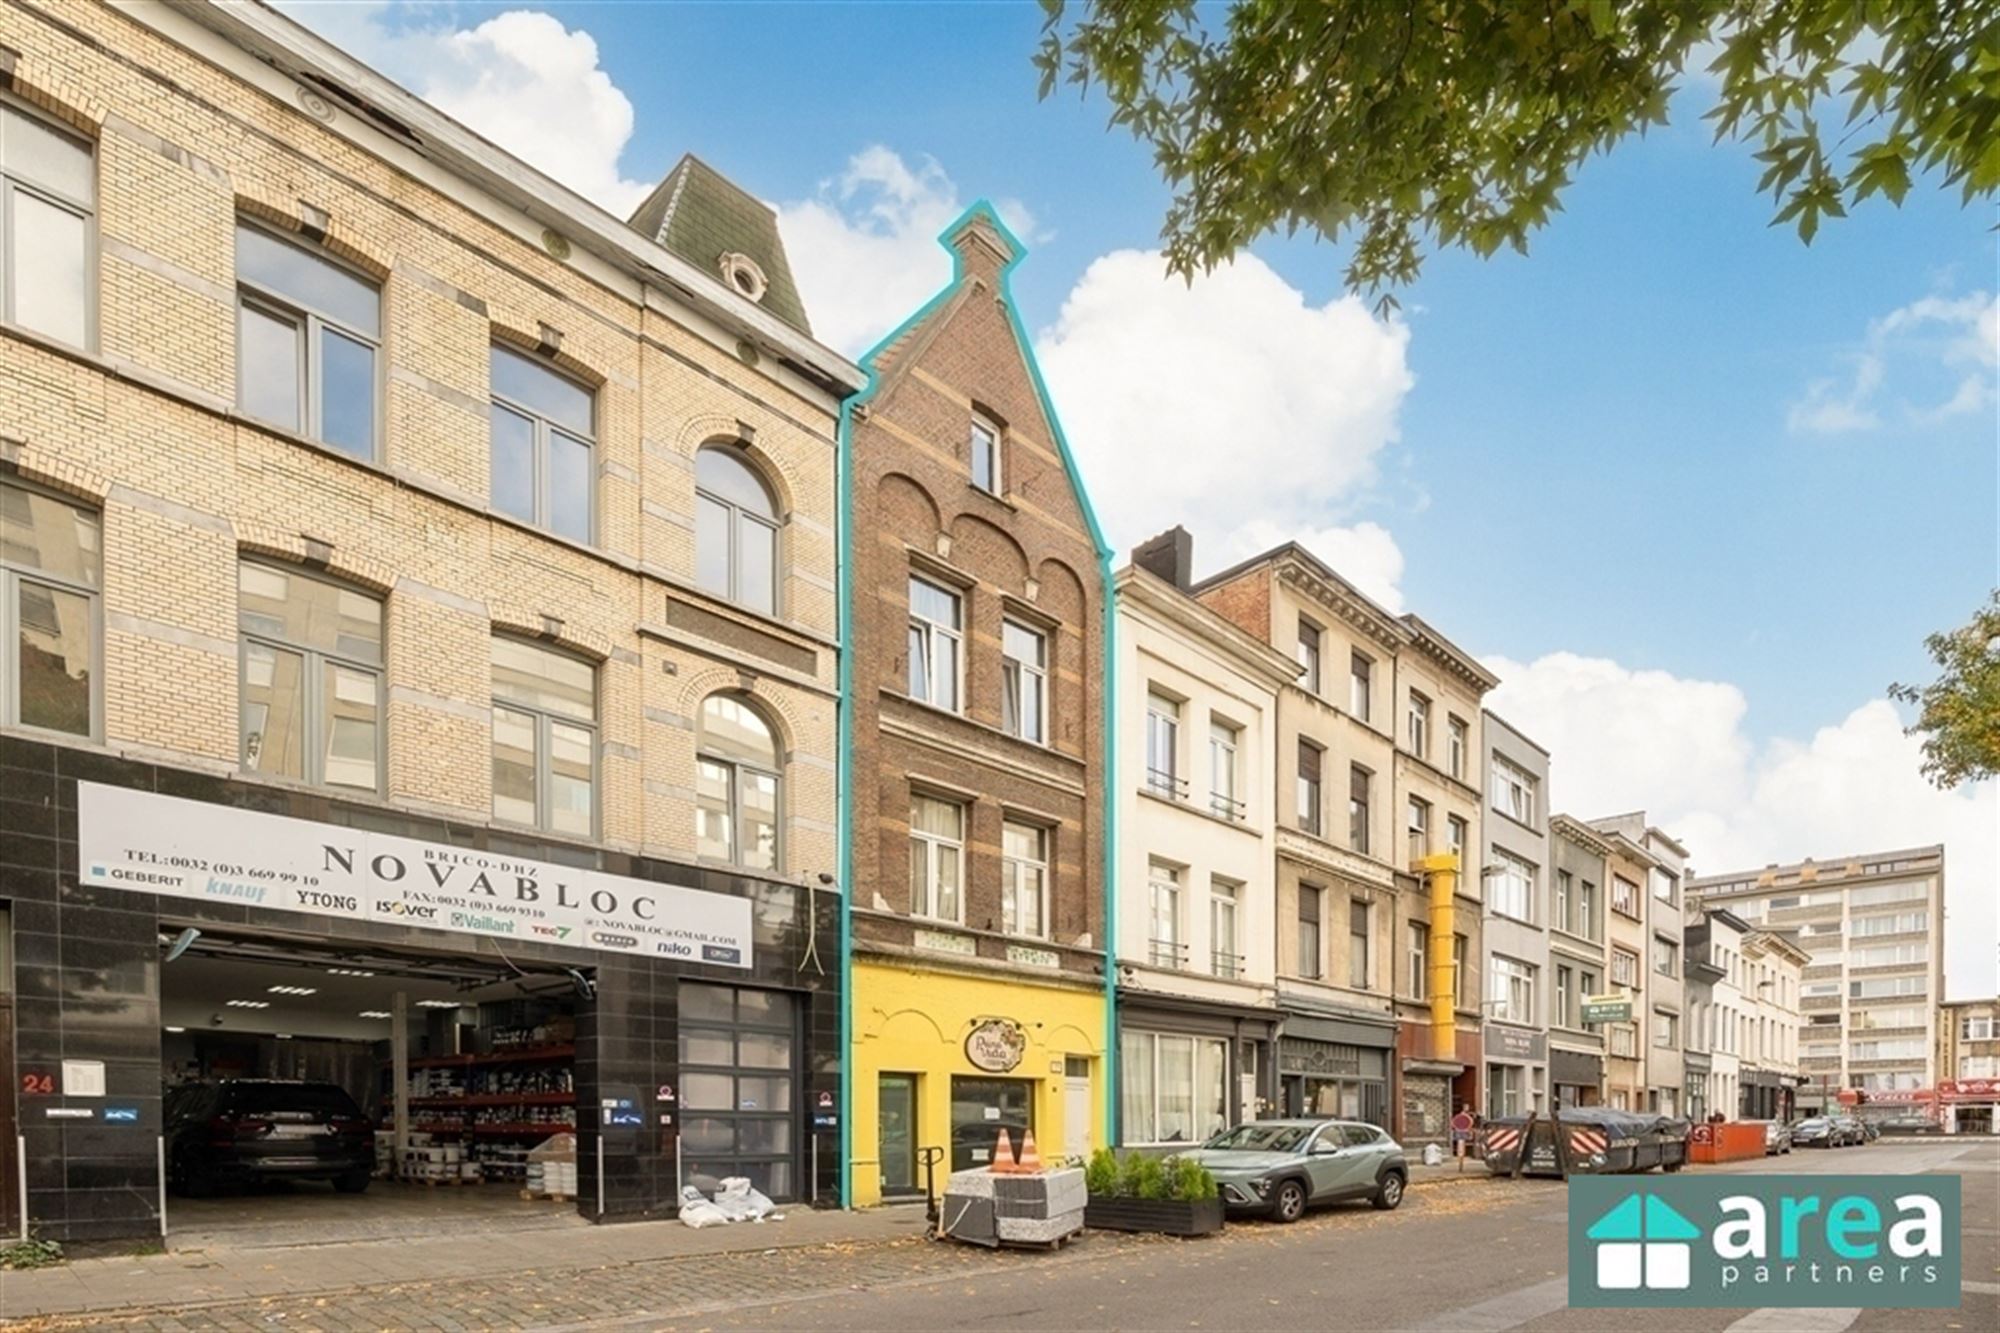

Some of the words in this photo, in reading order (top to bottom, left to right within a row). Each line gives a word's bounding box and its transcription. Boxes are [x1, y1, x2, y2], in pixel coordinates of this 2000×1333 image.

[124, 849, 208, 871] TEL:0032
[212, 863, 244, 876] (0)3
[248, 868, 276, 880] 669
[279, 872, 298, 883] 99
[303, 875, 320, 887] 10
[424, 849, 539, 878] BRICO-DHZ
[110, 868, 184, 888] GEBERIT
[322, 844, 656, 920] NOVABLOC
[296, 890, 357, 911] YTONG
[403, 890, 466, 908] FAX:0032
[469, 900, 494, 913] (0)3
[464, 914, 515, 934] Vaillant
[532, 925, 573, 940] TEC7
[656, 941, 692, 956] niko
[23, 1073, 54, 1094] 24
